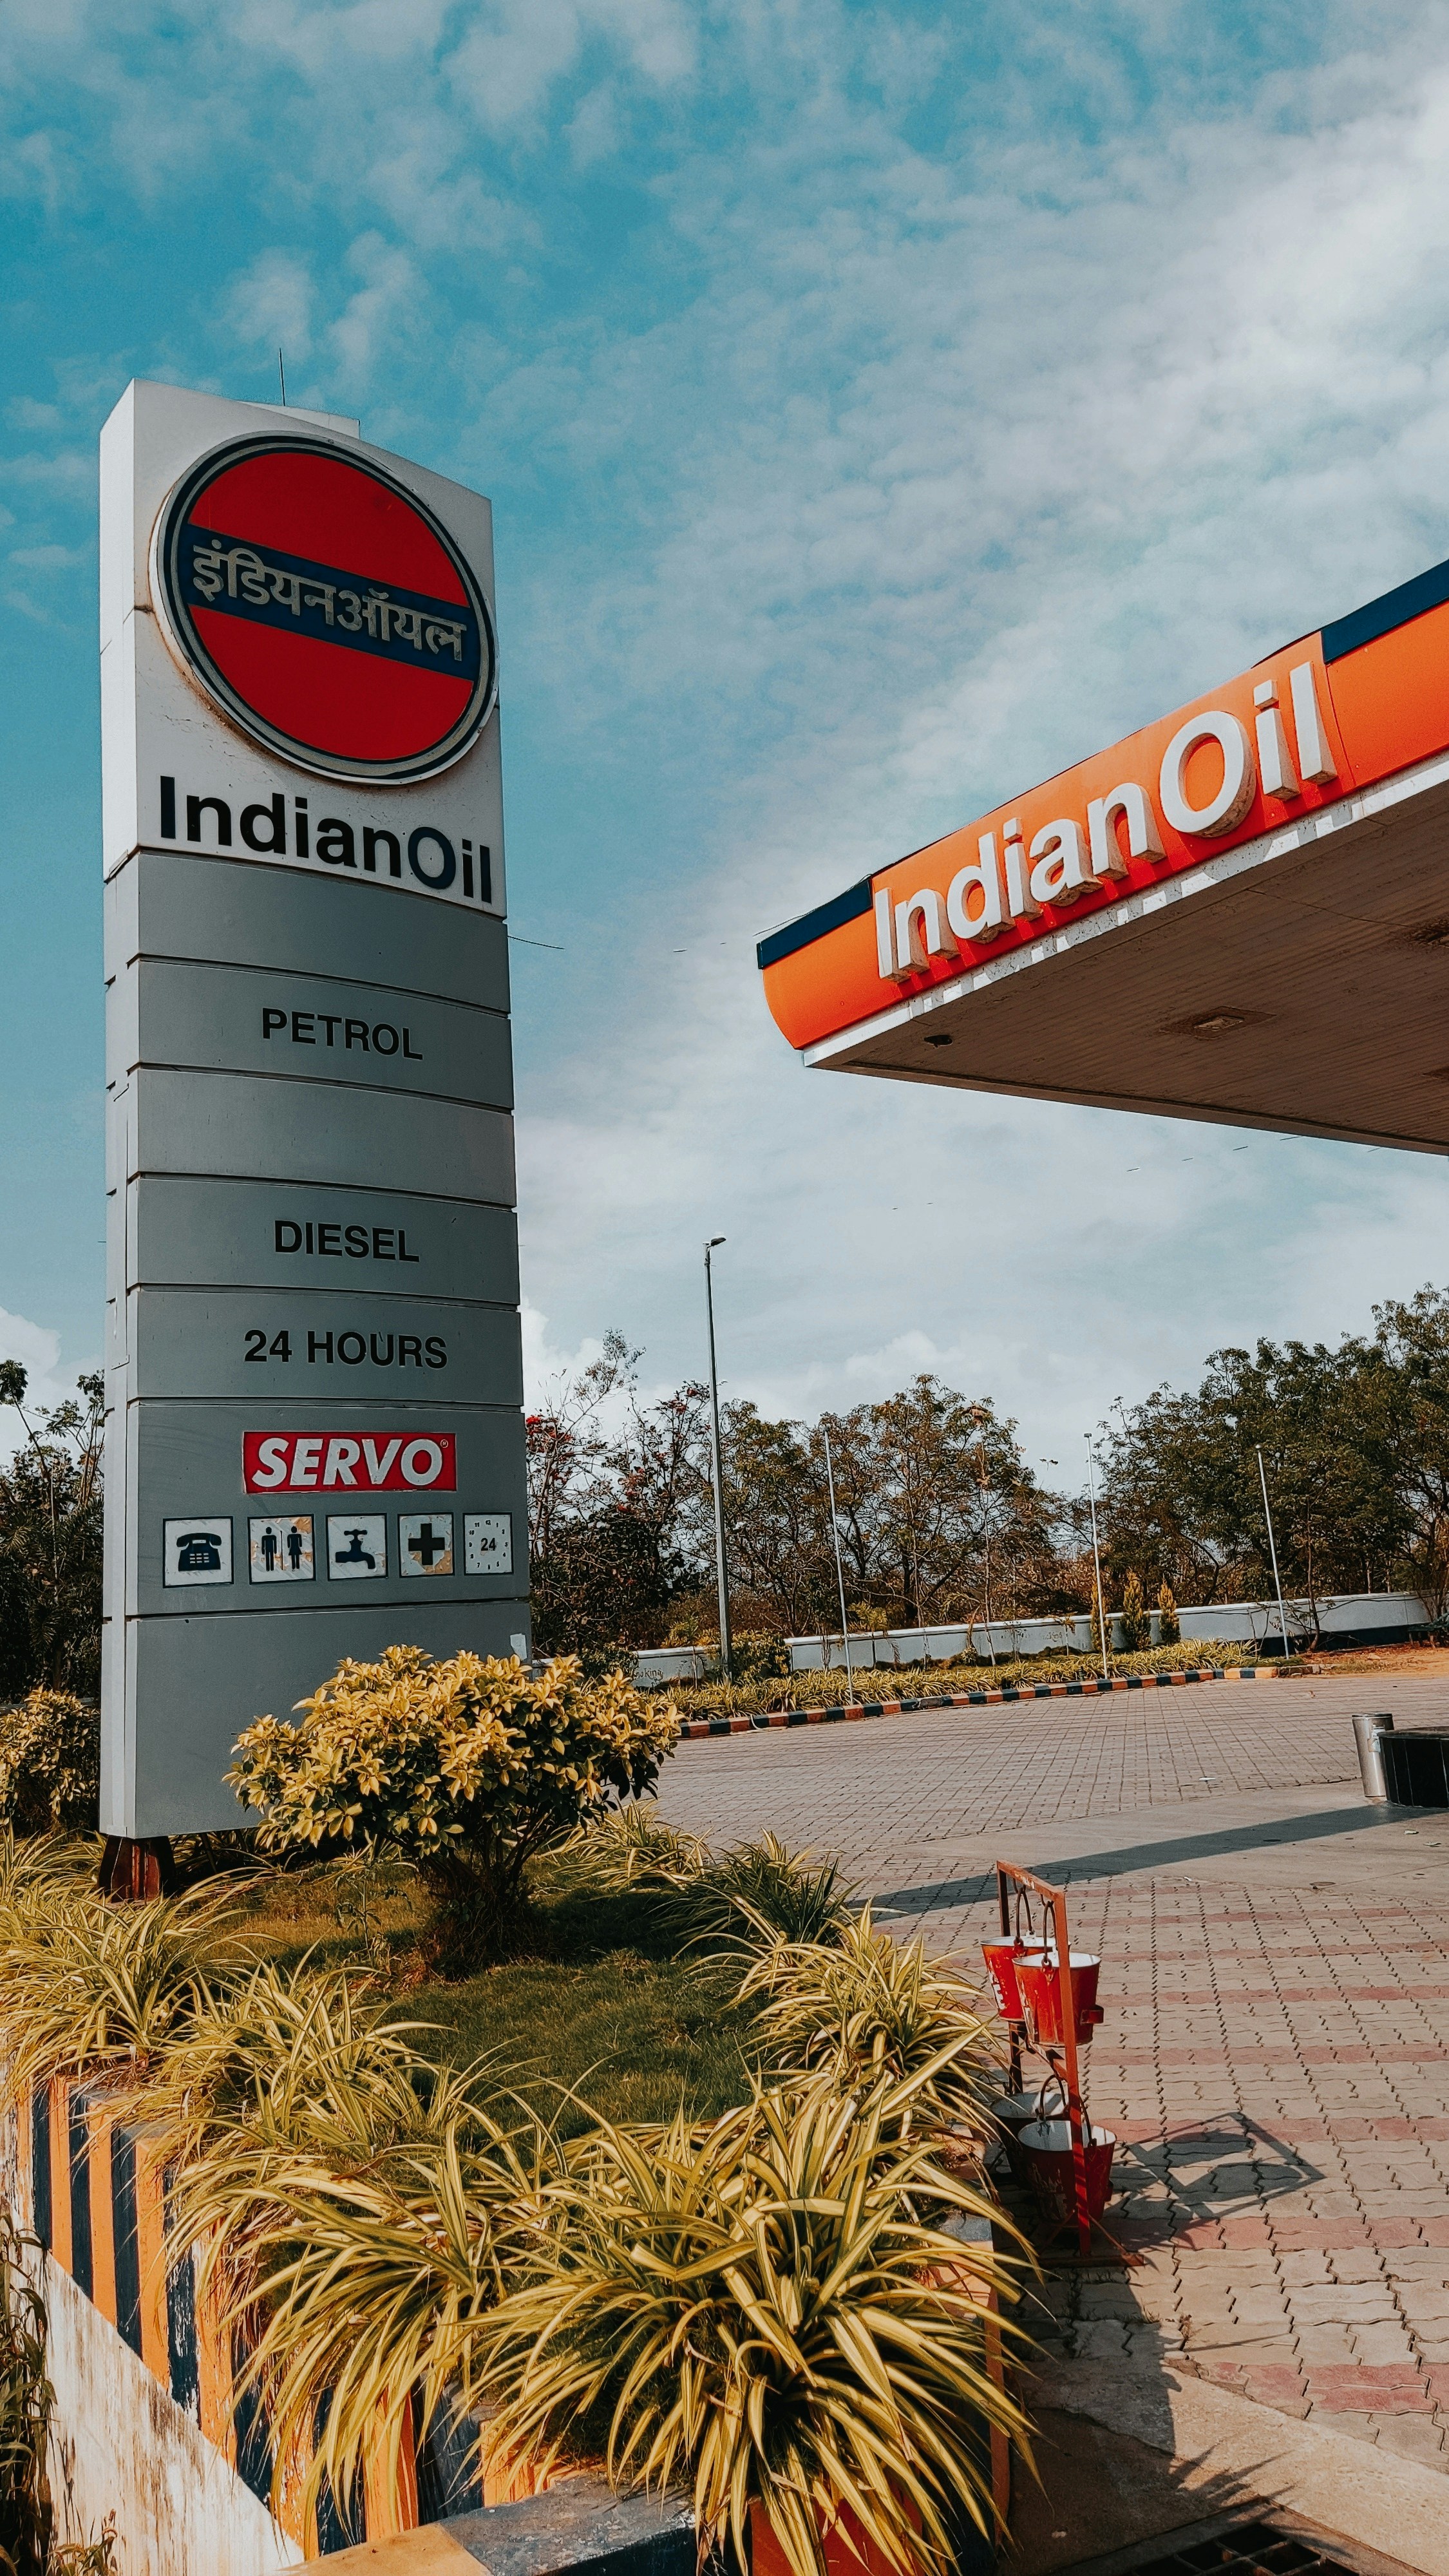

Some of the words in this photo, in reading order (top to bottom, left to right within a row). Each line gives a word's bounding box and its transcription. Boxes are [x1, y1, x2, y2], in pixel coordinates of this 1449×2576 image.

[194, 539, 468, 661] इंडियनऑयल
[160, 775, 493, 904] IndianOil
[873, 661, 1337, 982] IndianOil
[262, 1007, 423, 1061] PETROL
[274, 1220, 420, 1263] DIESEL
[244, 1329, 292, 1363] 24
[307, 1331, 448, 1370] HOURS
[251, 1437, 443, 1488] SERVO
[480, 1537, 497, 1551] 24
